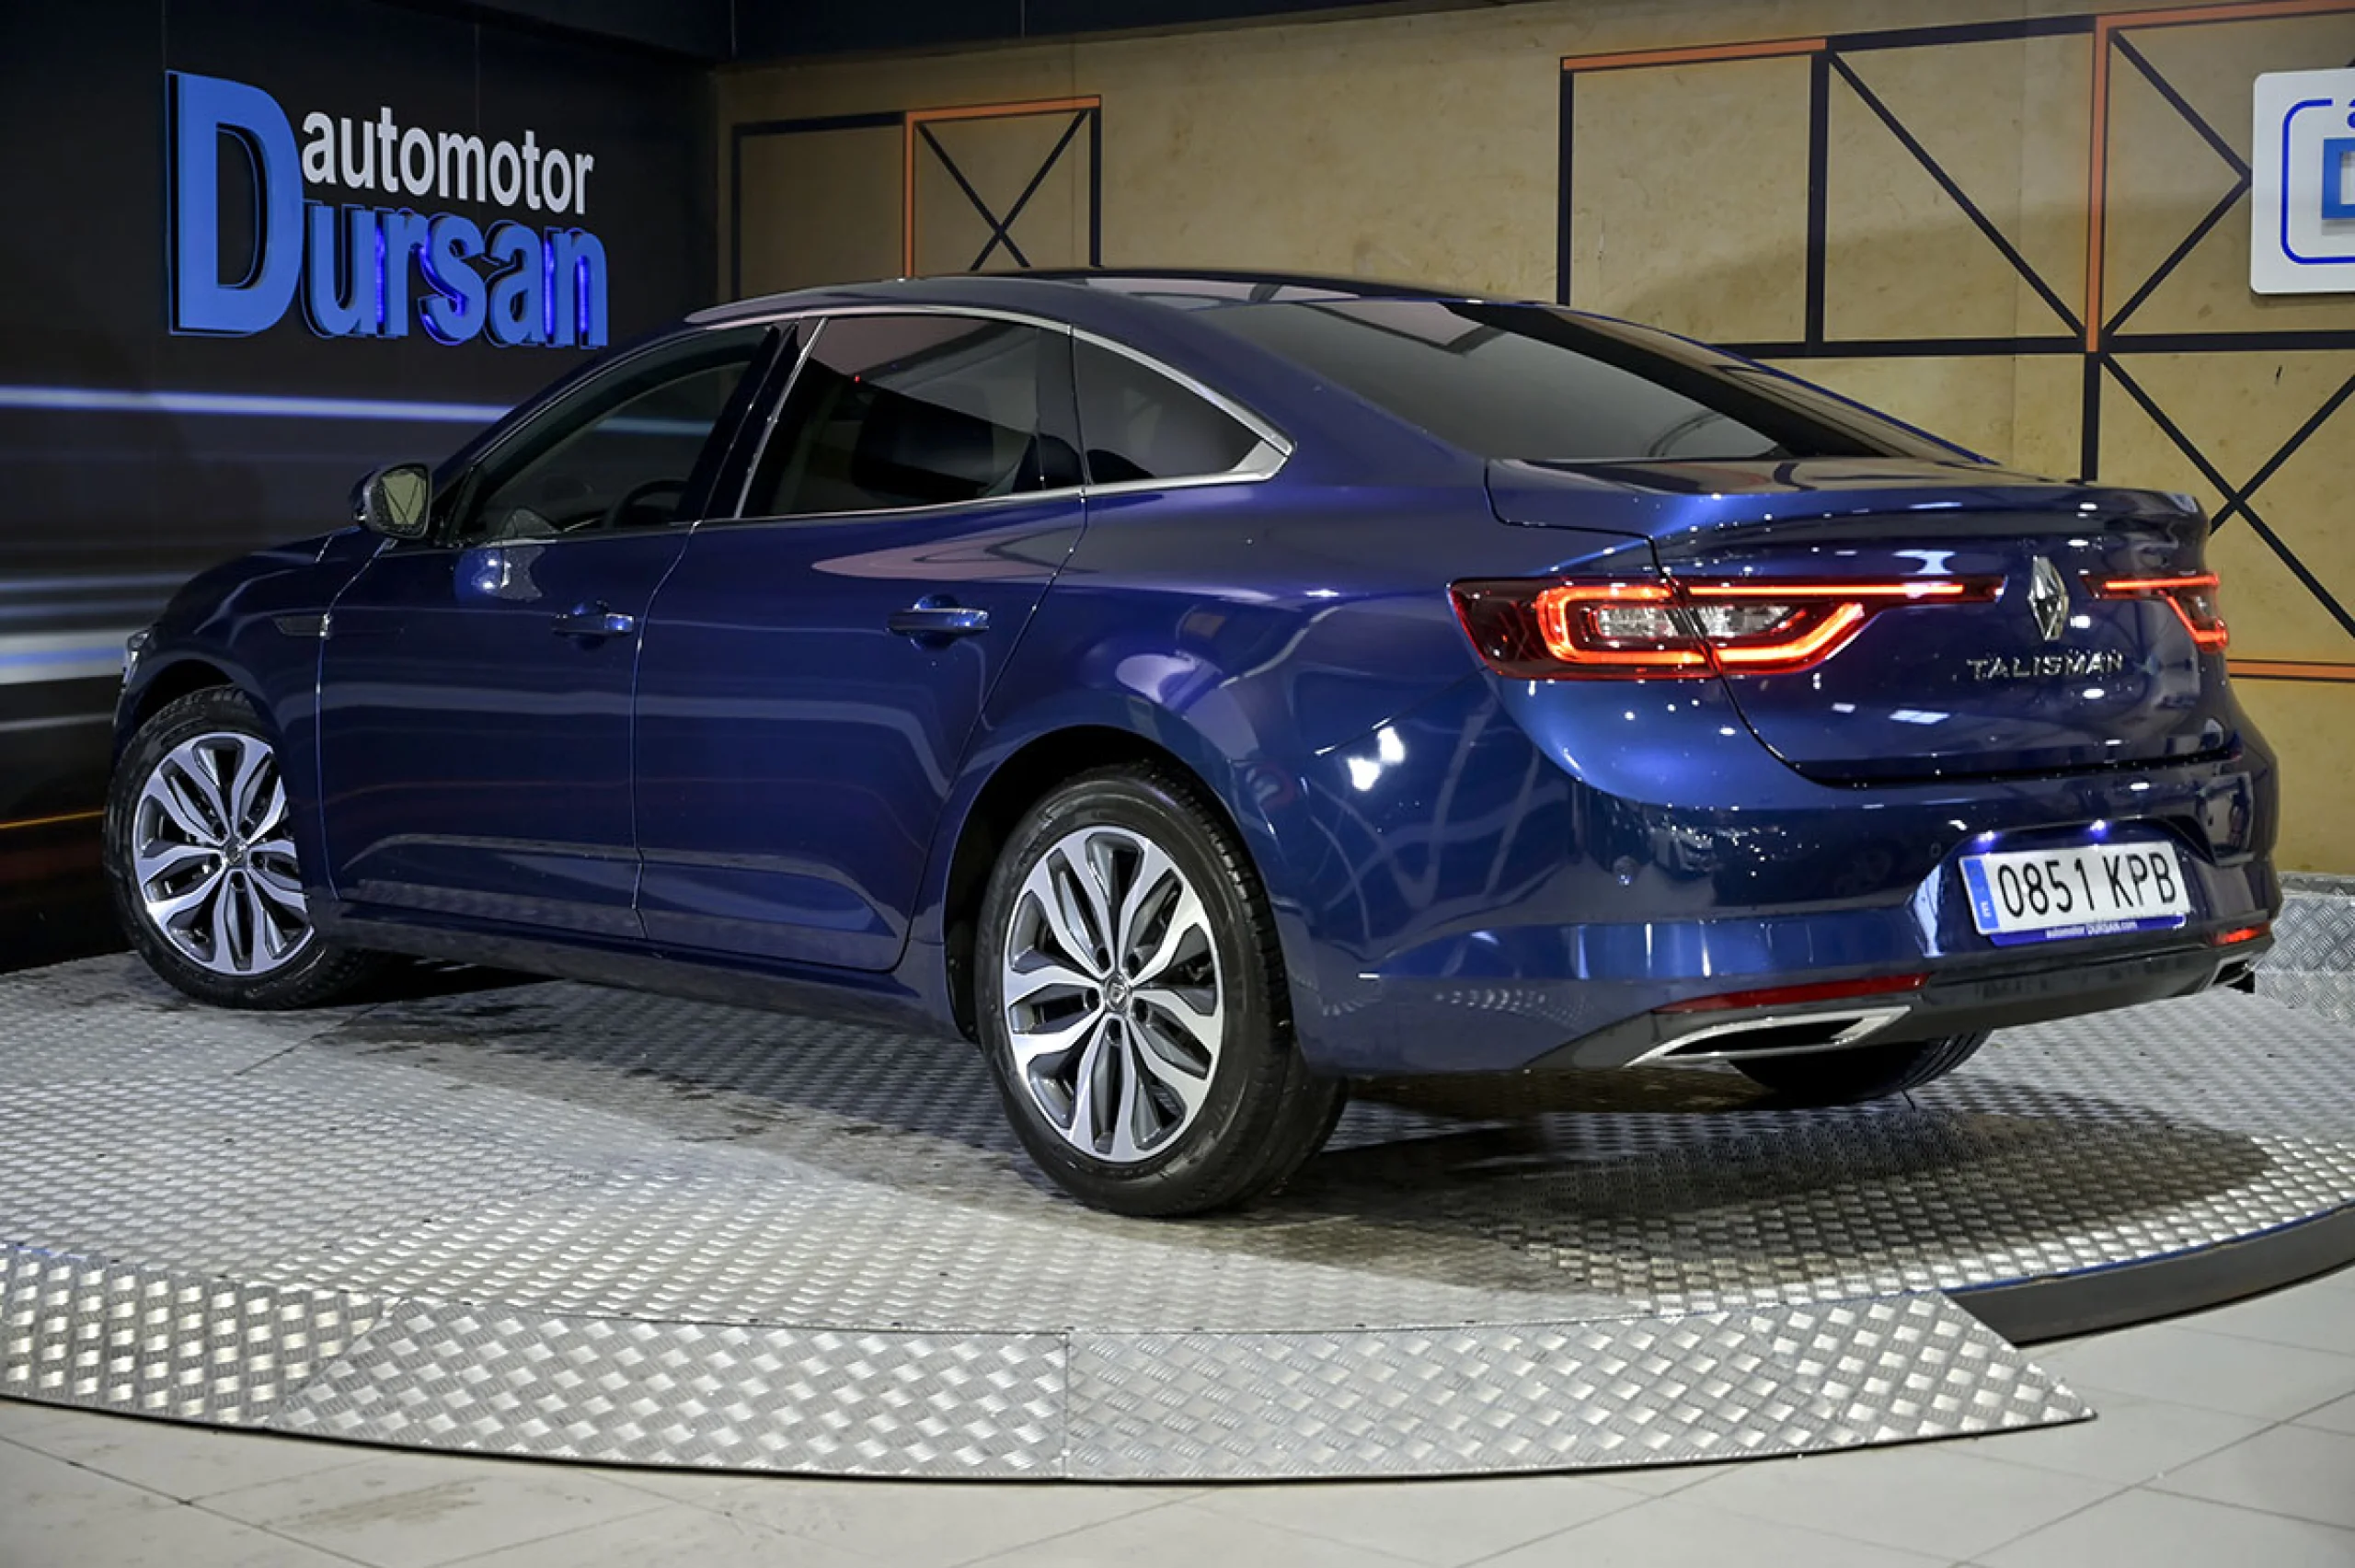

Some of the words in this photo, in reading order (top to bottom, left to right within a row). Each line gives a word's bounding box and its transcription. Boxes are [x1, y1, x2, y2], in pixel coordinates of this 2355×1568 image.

[302, 107, 594, 214] automotor
[165, 70, 608, 349] Dursan
[1966, 652, 2123, 680] TALISMAN
[1998, 857, 2095, 918] 0851
[2103, 852, 2176, 909] KPB
